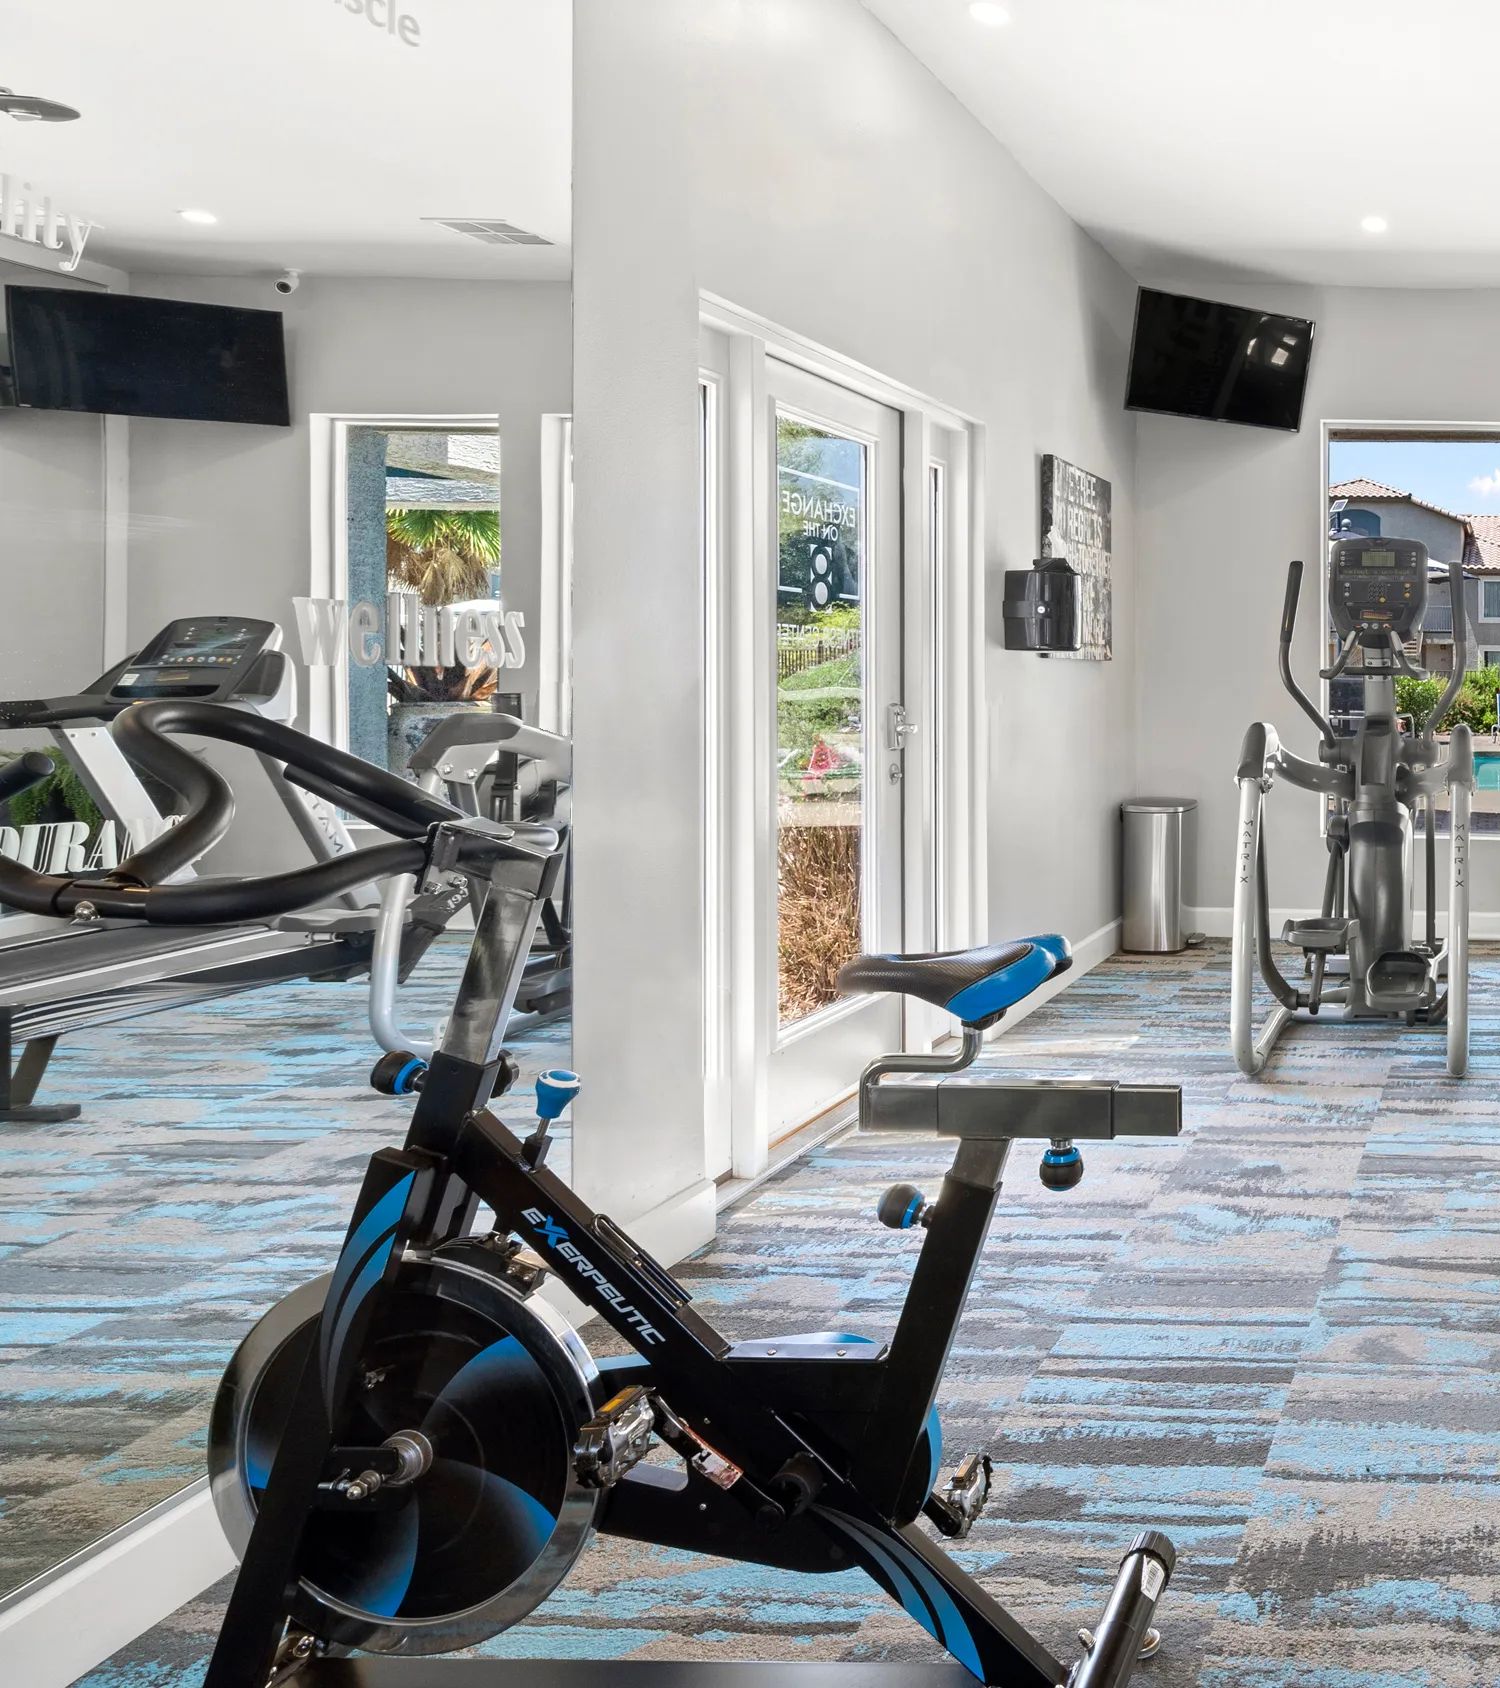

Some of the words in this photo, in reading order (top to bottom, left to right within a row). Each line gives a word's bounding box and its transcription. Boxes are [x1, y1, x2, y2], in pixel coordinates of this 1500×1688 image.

[292, 592, 525, 669] wellness
[1240, 820, 1254, 884] MATRIX
[1454, 823, 1465, 888] MATRIX
[520, 1207, 666, 1345] EXERPEUTIC
